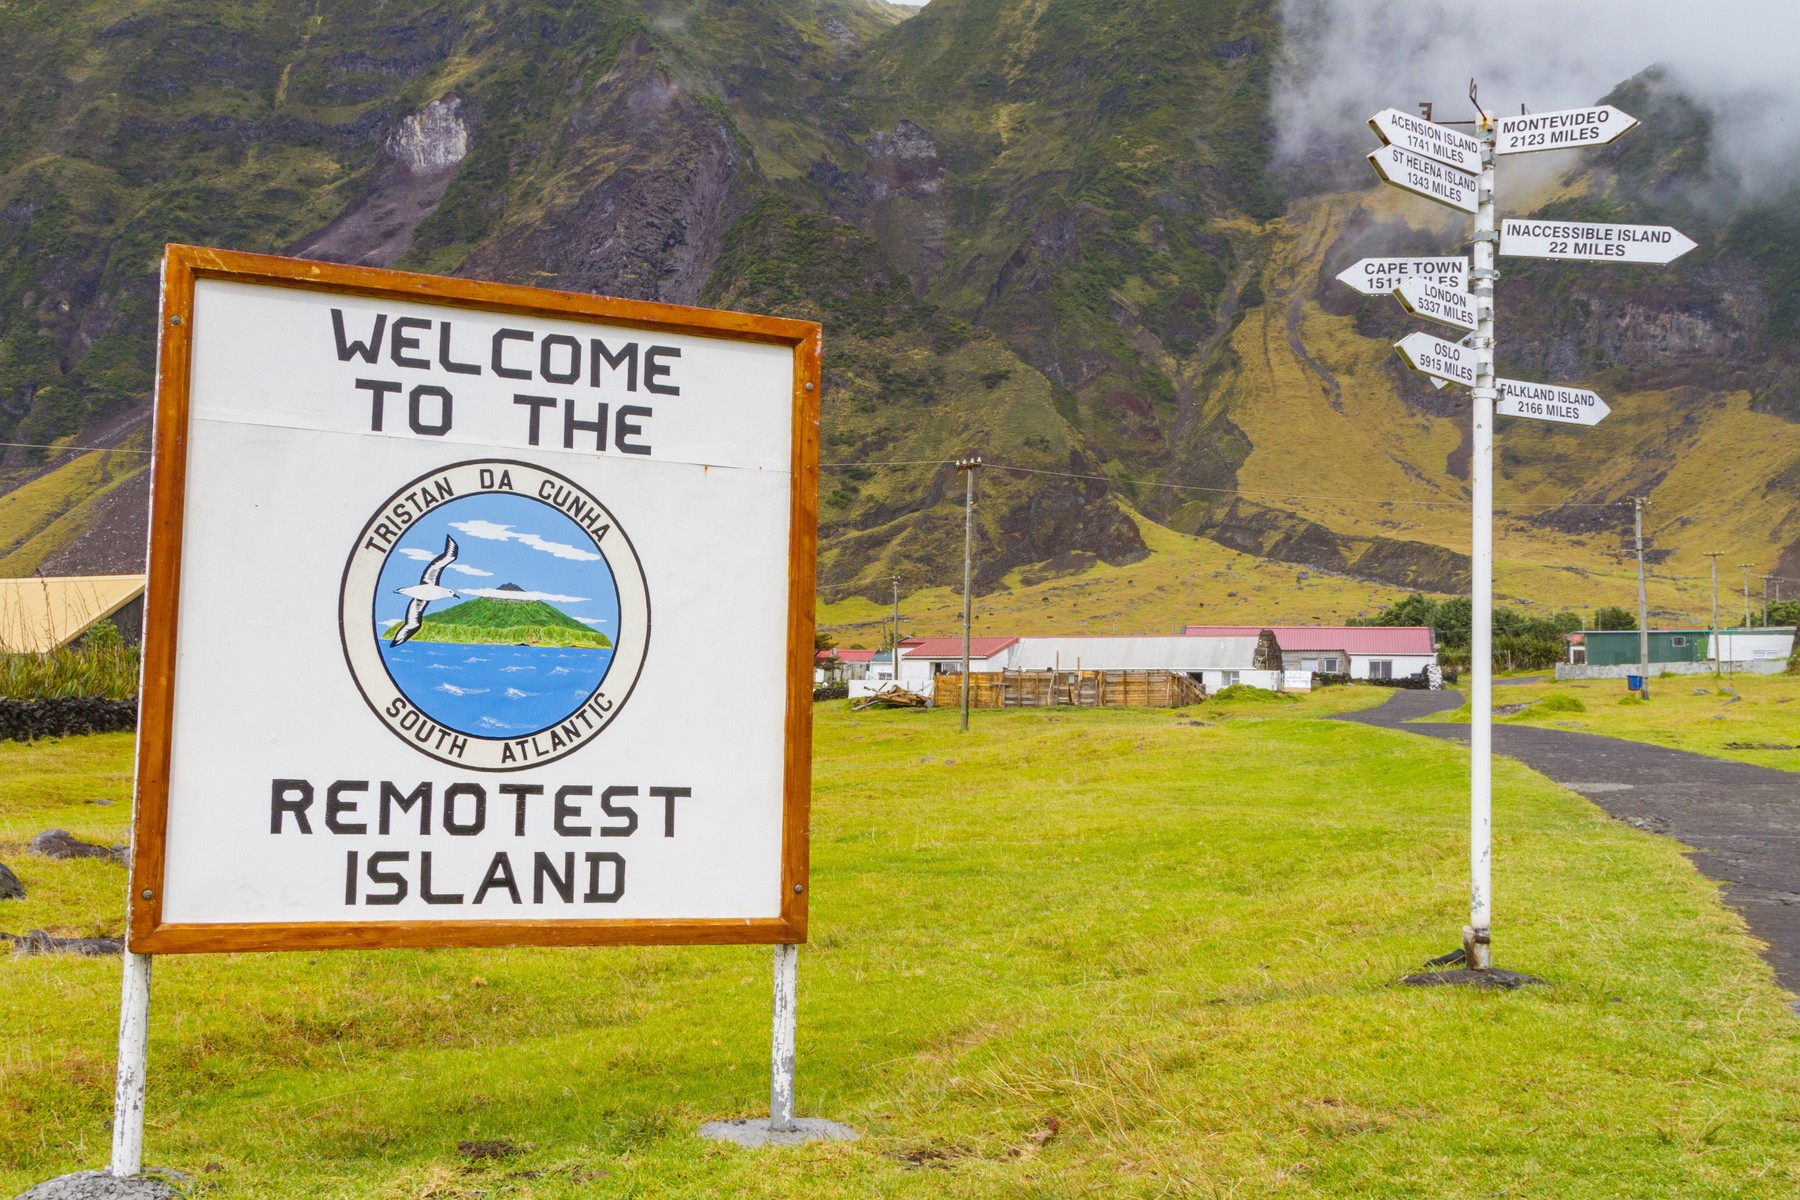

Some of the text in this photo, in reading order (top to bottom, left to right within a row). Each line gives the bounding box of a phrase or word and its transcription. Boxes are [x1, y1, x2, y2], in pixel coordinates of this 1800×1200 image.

[1391, 114, 1477, 153] ACENSION ISLAND
[1503, 110, 1609, 134] MONTEVIDEO
[1408, 135, 1464, 163] 1741 MILES
[1510, 126, 1600, 148] 2123 MILES
[1393, 149, 1476, 192] ST HELENA ISLAND
[1408, 172, 1462, 202] 1343 MILES
[1507, 224, 1672, 243] INACCESSIBLE ISLAND
[1549, 242, 1626, 256] 22 MILES
[1364, 262, 1462, 275] CAPE TOWN
[1367, 278, 1401, 289] 1511
[1424, 284, 1466, 307] LONDON
[1418, 298, 1474, 324] 5337 MILES
[330, 308, 682, 397] WELCOME
[1434, 343, 1460, 361] OSLO
[1419, 354, 1473, 381] 5915 MILES
[1501, 383, 1595, 407] FALKLAND ISLAND
[355, 378, 653, 456] TO THE
[1518, 401, 1580, 419] 2166 MILES
[364, 468, 611, 554] TRISTAN DA CUNHA
[385, 691, 613, 764] SOUTH ATLANTIC
[270, 778, 692, 838] REMOTEST
[344, 850, 626, 906] ISLAND
